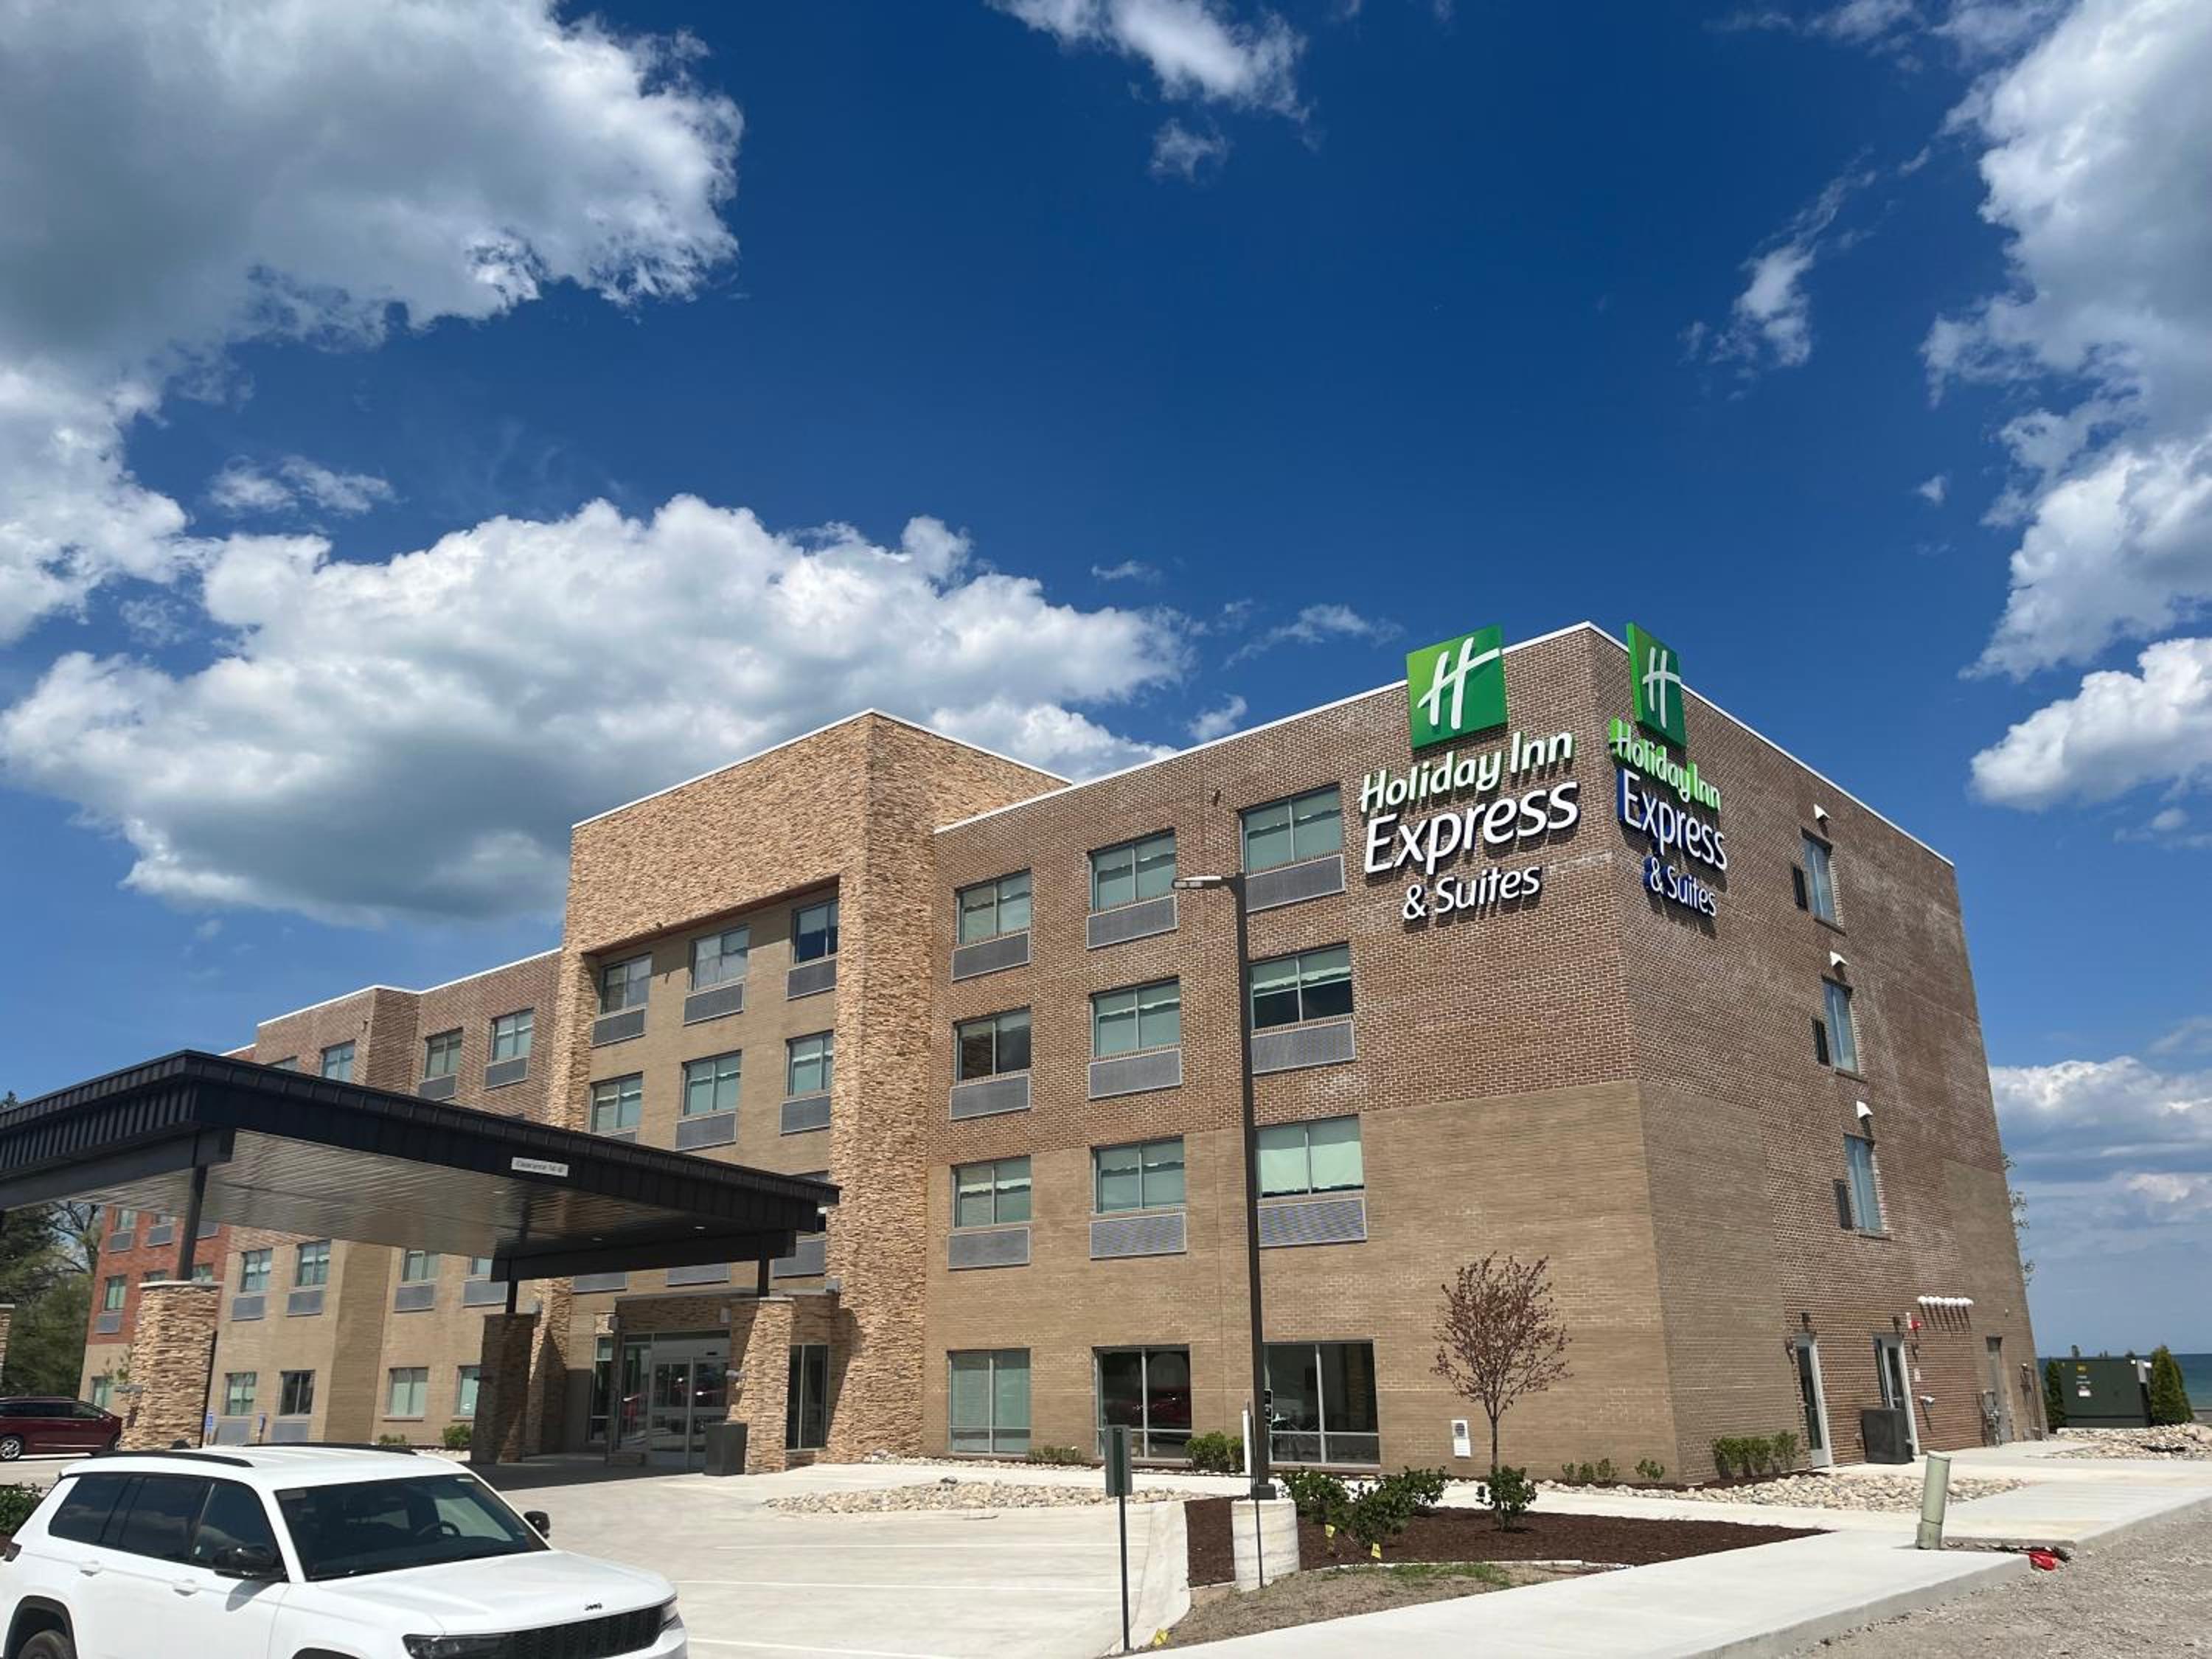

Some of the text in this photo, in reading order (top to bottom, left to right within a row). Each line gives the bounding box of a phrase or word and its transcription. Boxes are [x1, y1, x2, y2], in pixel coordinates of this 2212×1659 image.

[1360, 731, 1573, 812] Holiday Inn
[1611, 717, 1721, 811] Holiday Inn
[1365, 782, 1579, 875] Express
[1621, 768, 1728, 871] Express
[1402, 866, 1540, 920] & Suites
[1647, 856, 1717, 917] & Suites
